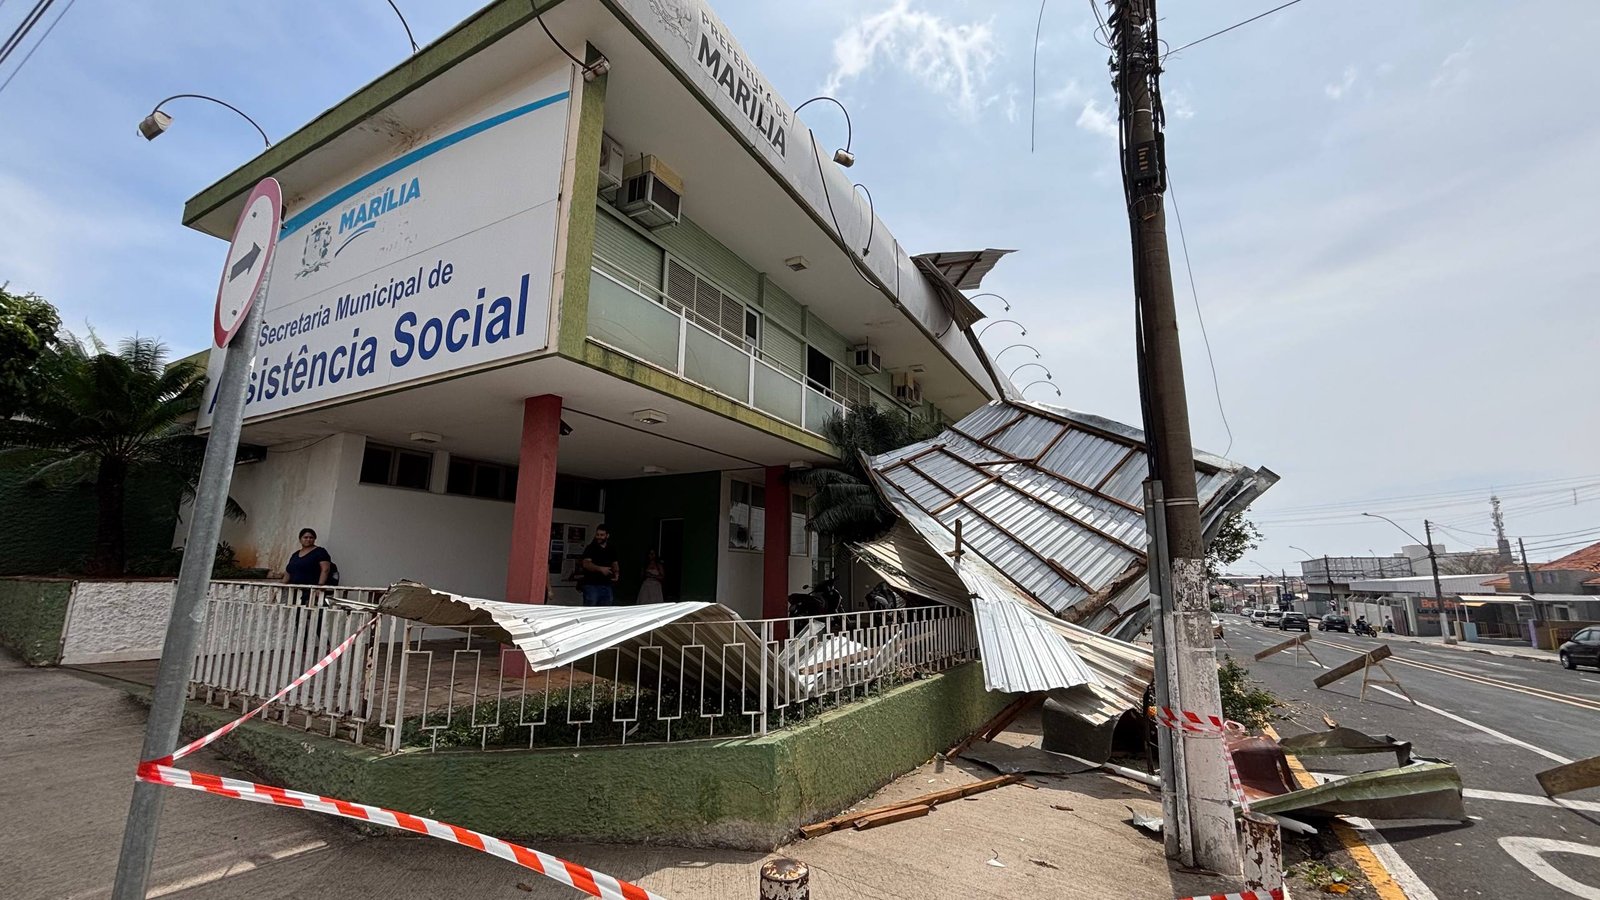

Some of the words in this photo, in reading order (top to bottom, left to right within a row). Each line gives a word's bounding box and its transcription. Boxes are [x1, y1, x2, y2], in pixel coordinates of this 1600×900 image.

[697, 32, 786, 158] MARÍLIA
[701, 10, 774, 108] PREFEITUA
[775, 104, 790, 126] DE
[338, 177, 421, 235] MARÍLIA
[208, 328, 378, 414] sistência
[390, 273, 530, 368] Social
[259, 305, 331, 347] Secretaria
[335, 267, 423, 321] Municipal
[428, 260, 454, 289] de
